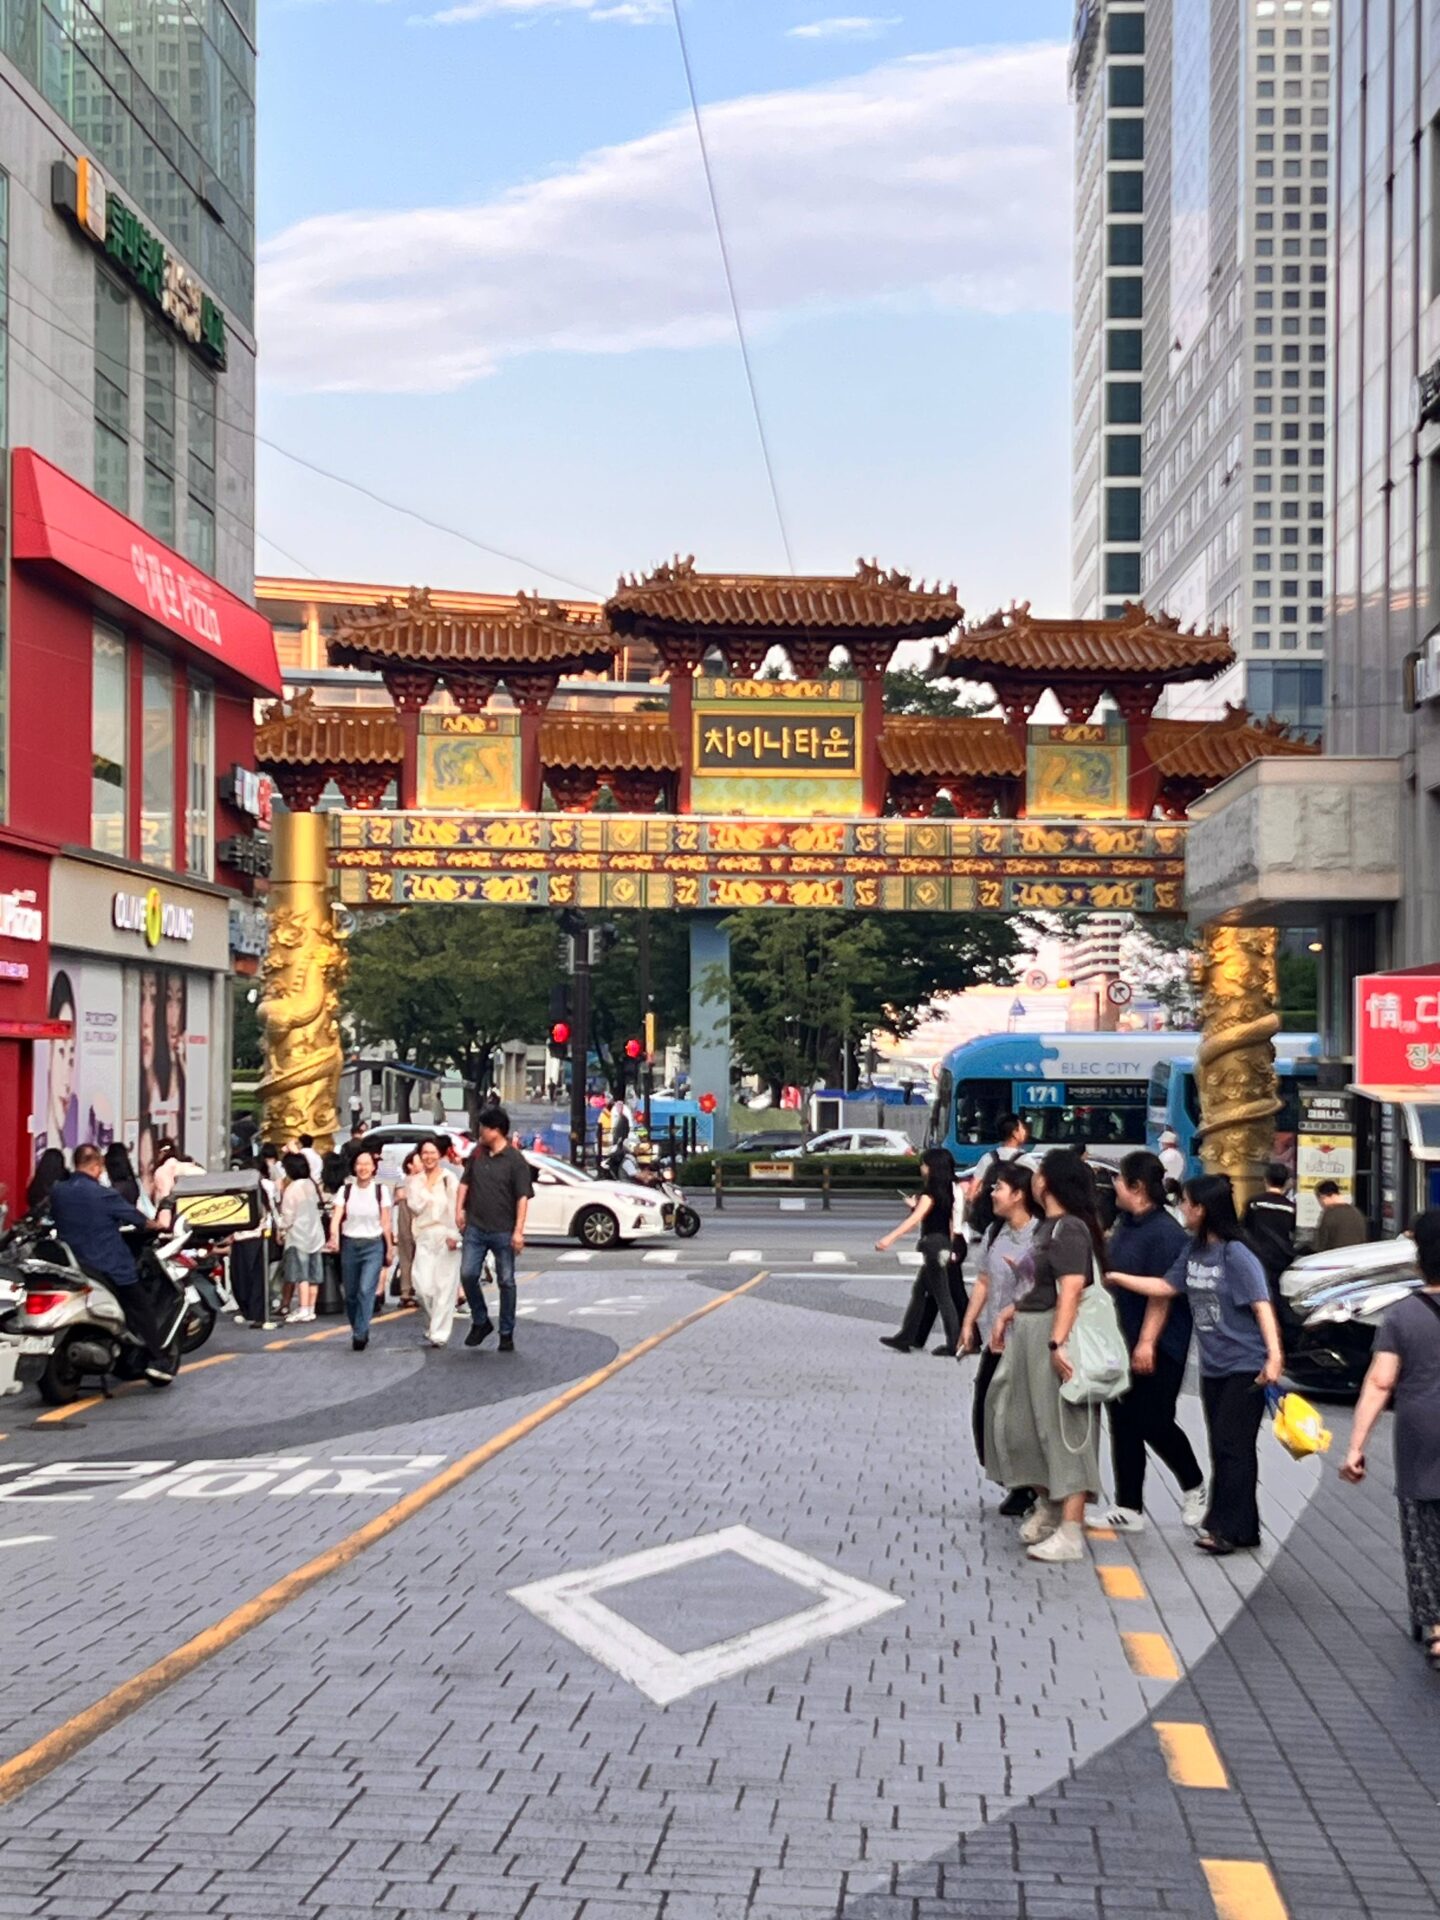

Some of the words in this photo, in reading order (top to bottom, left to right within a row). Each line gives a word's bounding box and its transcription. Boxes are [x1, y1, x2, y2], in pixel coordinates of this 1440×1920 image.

[704, 725, 850, 759] 차이나타운
[114, 892, 147, 931] OLIVE
[162, 903, 194, 940] YOUNG
[1061, 1062, 1101, 1075] ELEC
[1106, 1062, 1141, 1075] CITY
[1026, 1086, 1057, 1103] 171
[0, 1455, 447, 1500] 진입금
